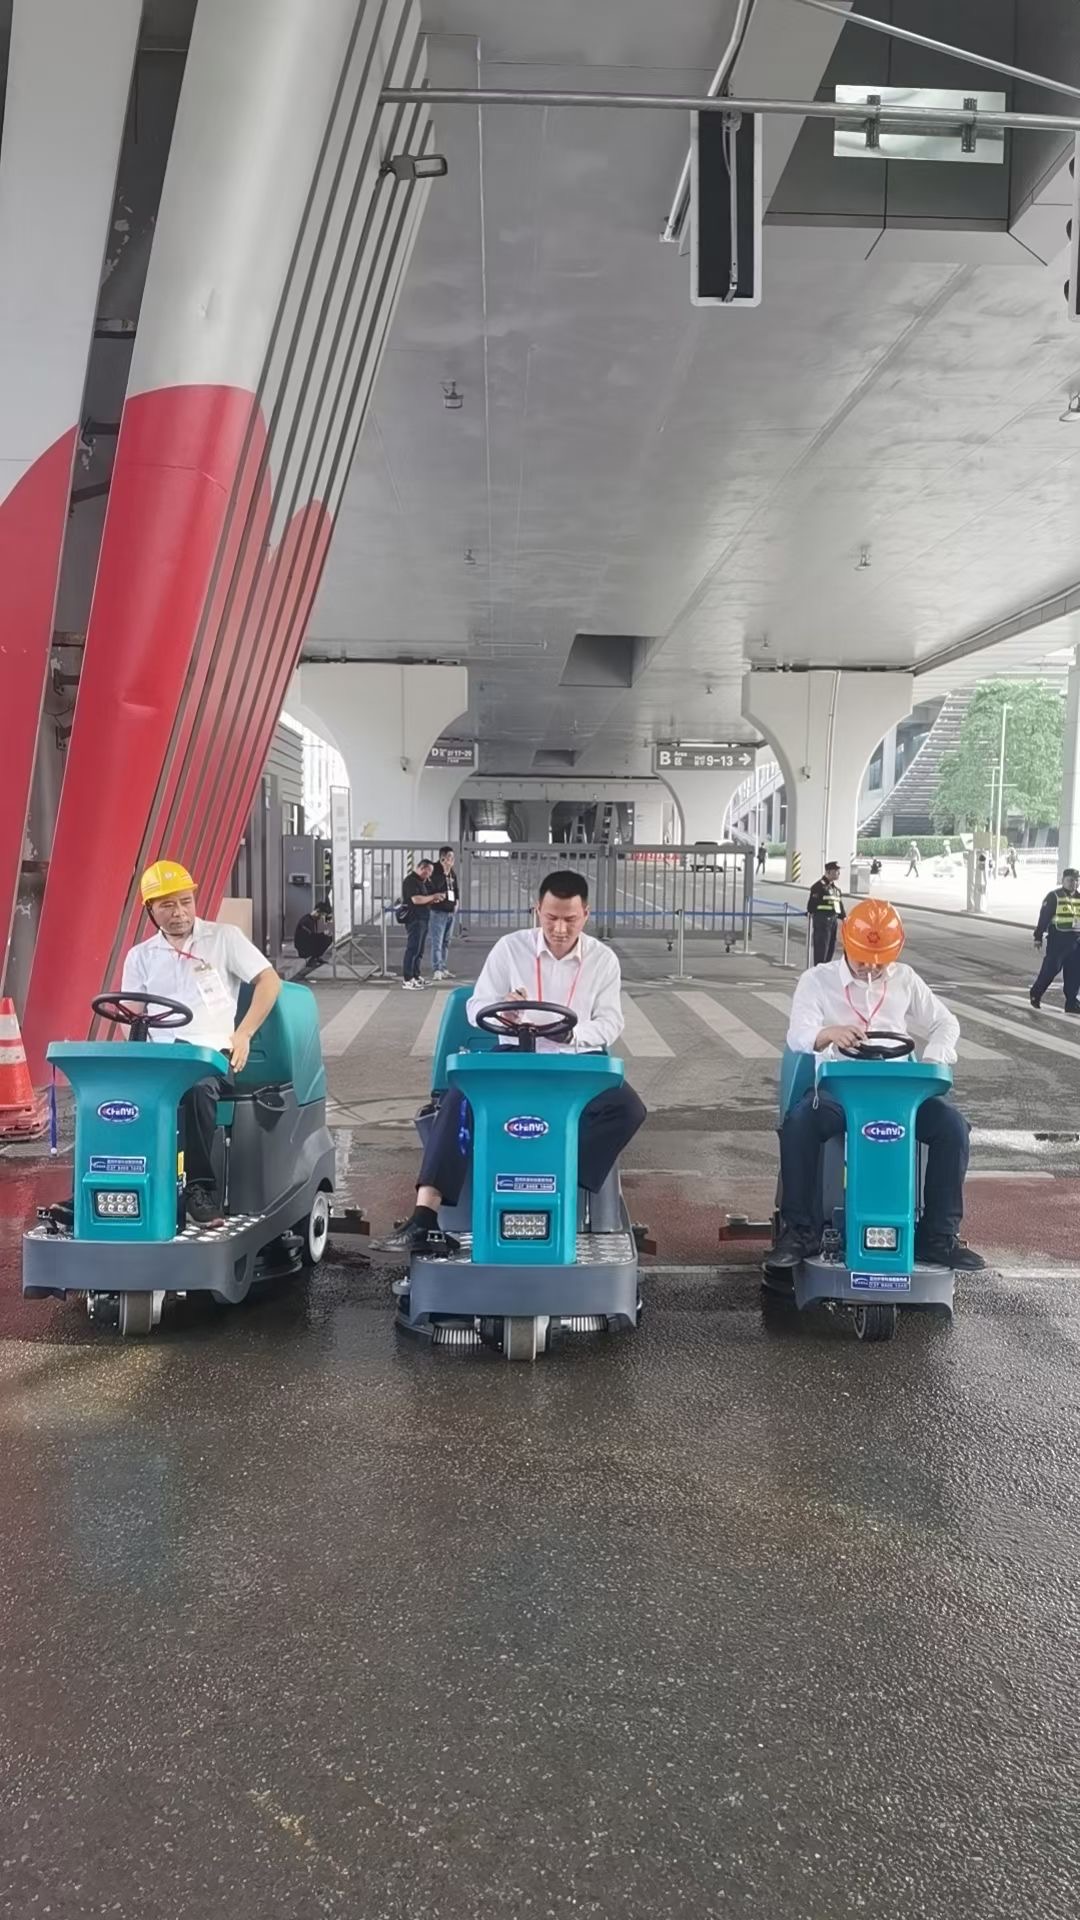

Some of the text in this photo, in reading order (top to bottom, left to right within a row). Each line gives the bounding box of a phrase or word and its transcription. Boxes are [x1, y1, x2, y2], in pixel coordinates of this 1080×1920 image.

[431, 747, 439, 757] D
[660, 751, 671, 766] B
[706, 755, 734, 767] 9-13
